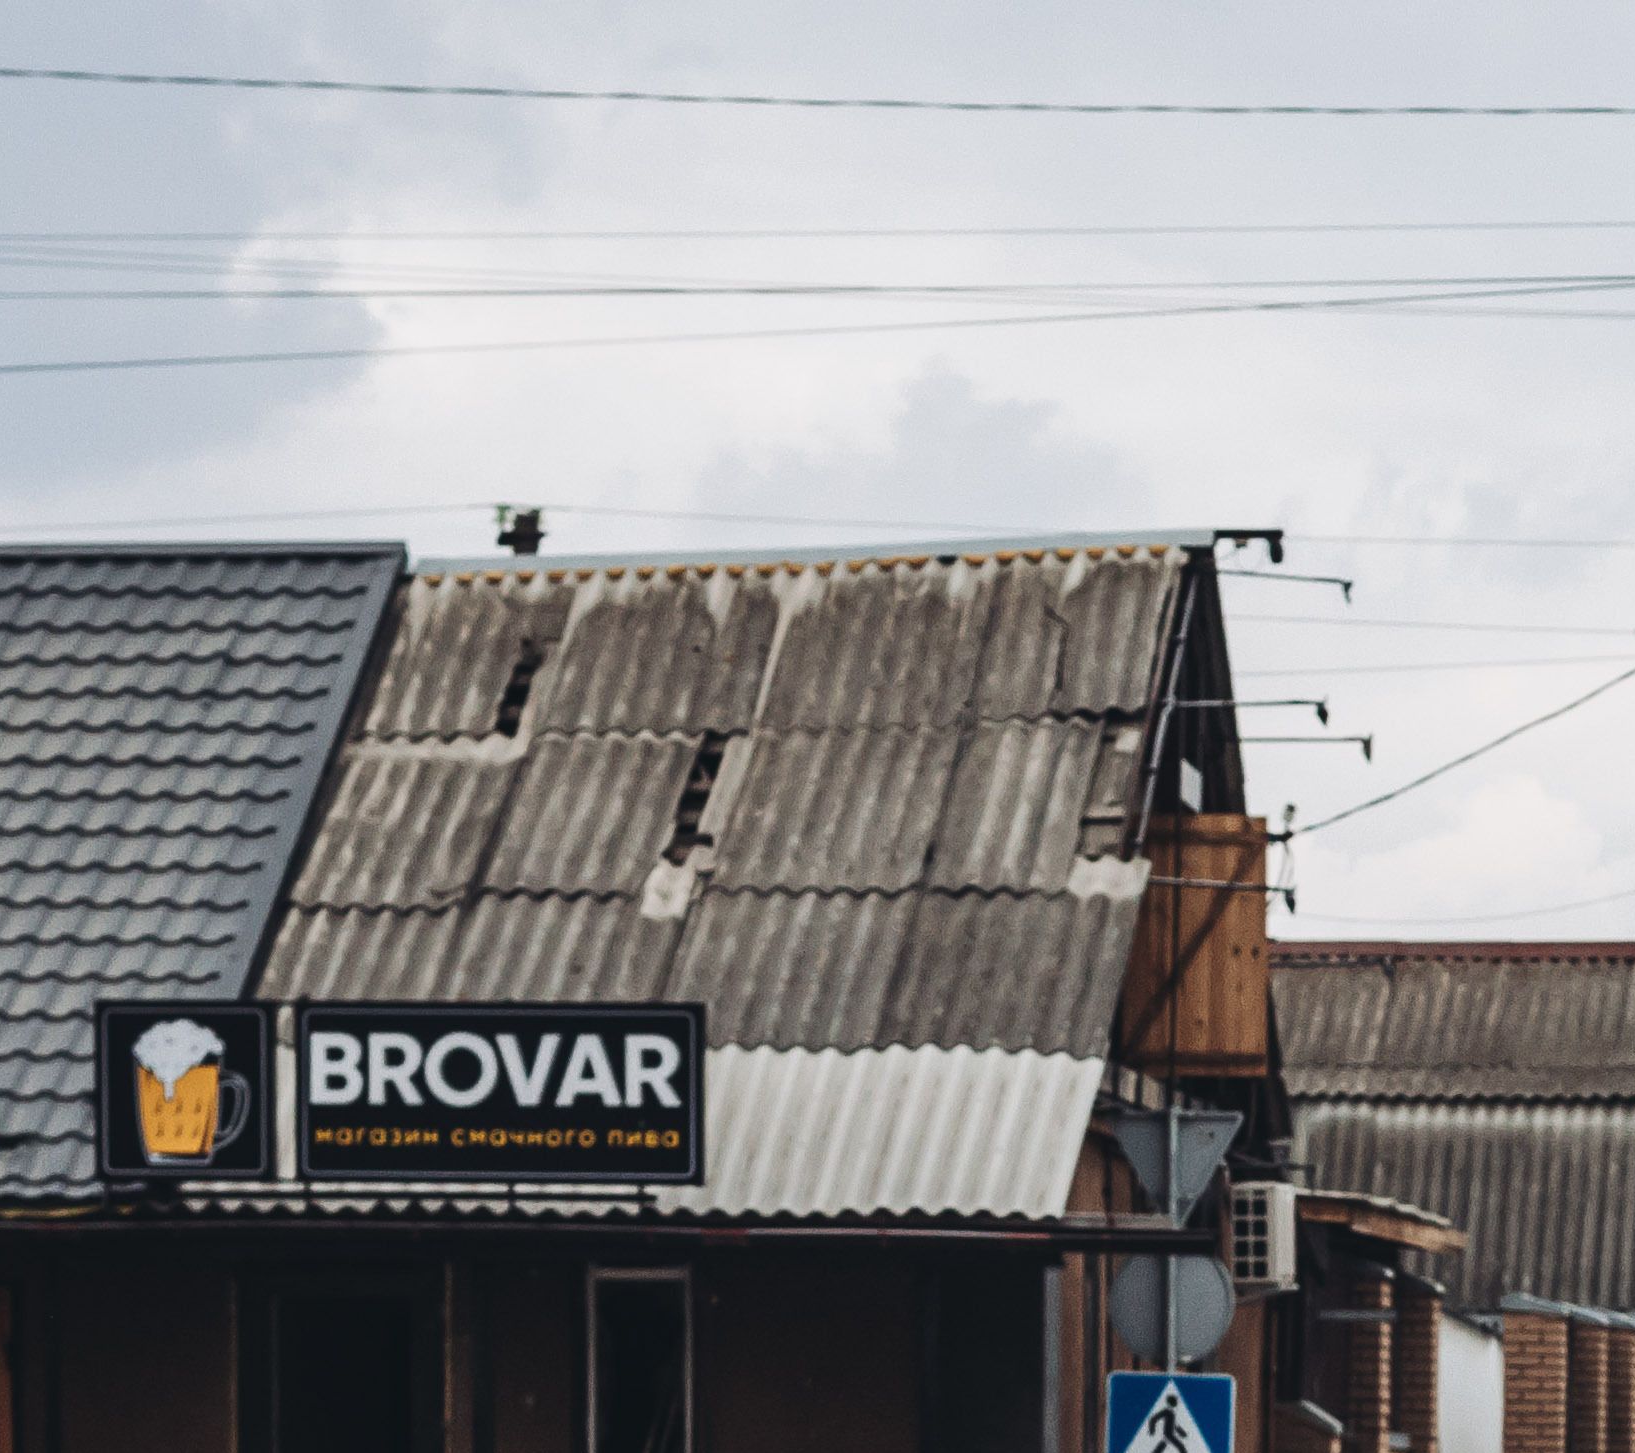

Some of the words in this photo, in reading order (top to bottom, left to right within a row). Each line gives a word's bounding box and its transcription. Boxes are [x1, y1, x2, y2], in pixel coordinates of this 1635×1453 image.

[308, 1031, 682, 1107] BROVAR
[315, 1127, 440, 1147] магазин
[450, 1127, 598, 1147] смачного
[607, 1127, 680, 1148] пива
